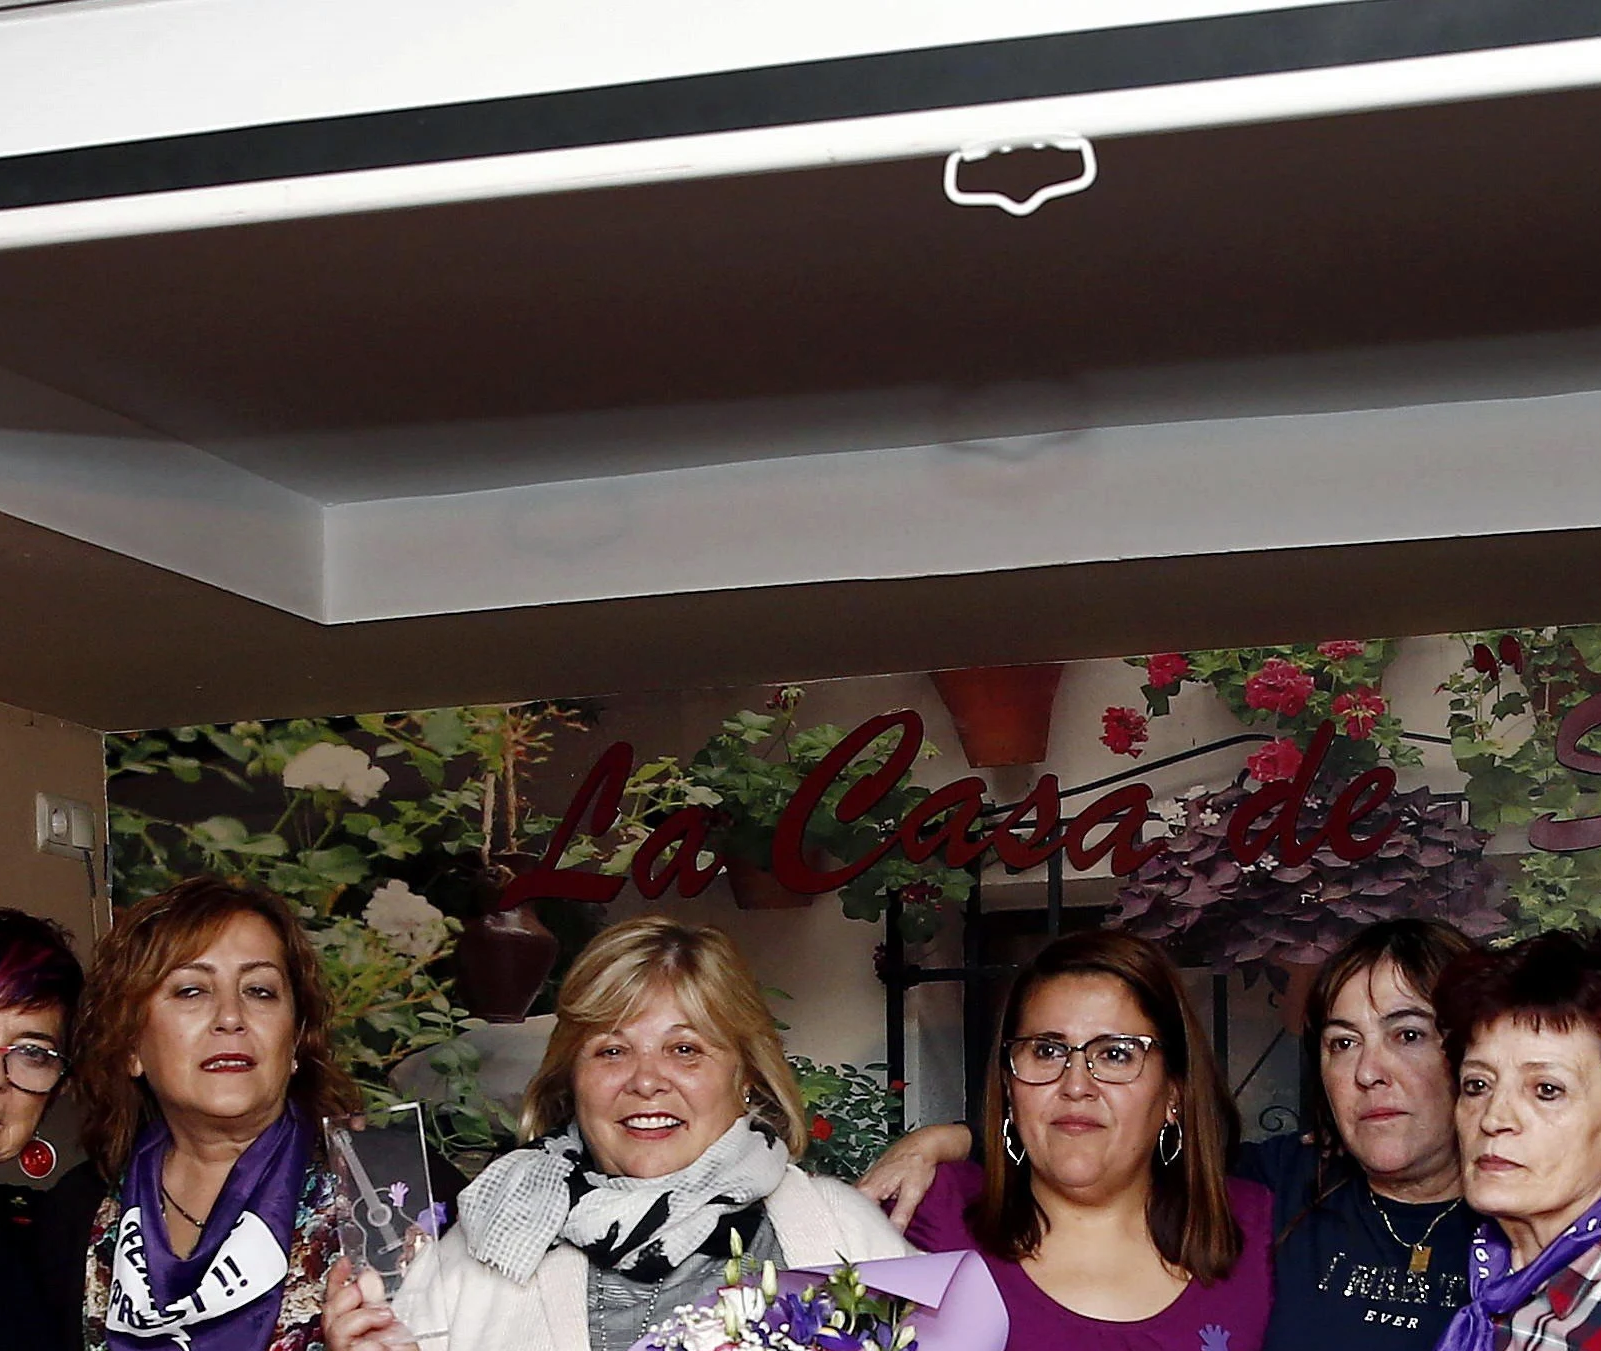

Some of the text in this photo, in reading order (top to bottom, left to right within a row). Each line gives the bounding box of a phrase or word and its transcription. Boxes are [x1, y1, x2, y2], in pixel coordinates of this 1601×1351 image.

[495, 741, 725, 911] La
[771, 708, 1173, 895] Casa
[1226, 719, 1400, 867] de
[1363, 1309, 1420, 1330] EVER
